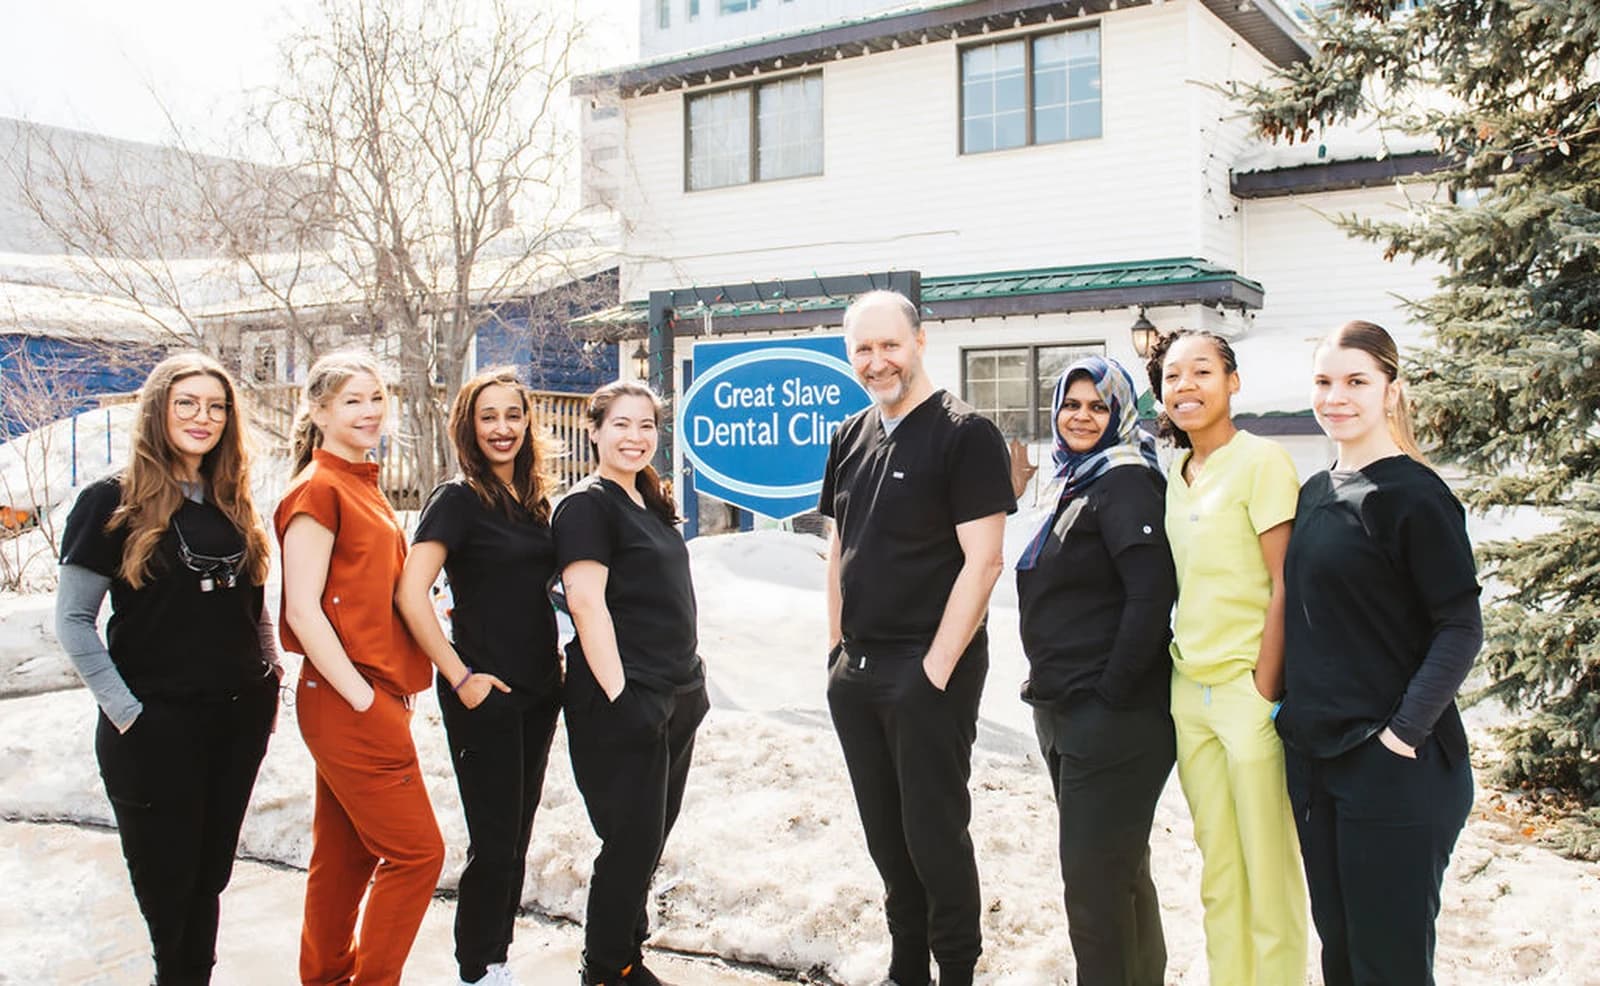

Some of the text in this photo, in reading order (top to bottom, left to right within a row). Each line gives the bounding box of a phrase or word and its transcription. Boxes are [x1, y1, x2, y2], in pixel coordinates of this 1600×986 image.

[714, 377, 841, 408] Great Slave
[693, 412, 850, 446] Dental Clin
